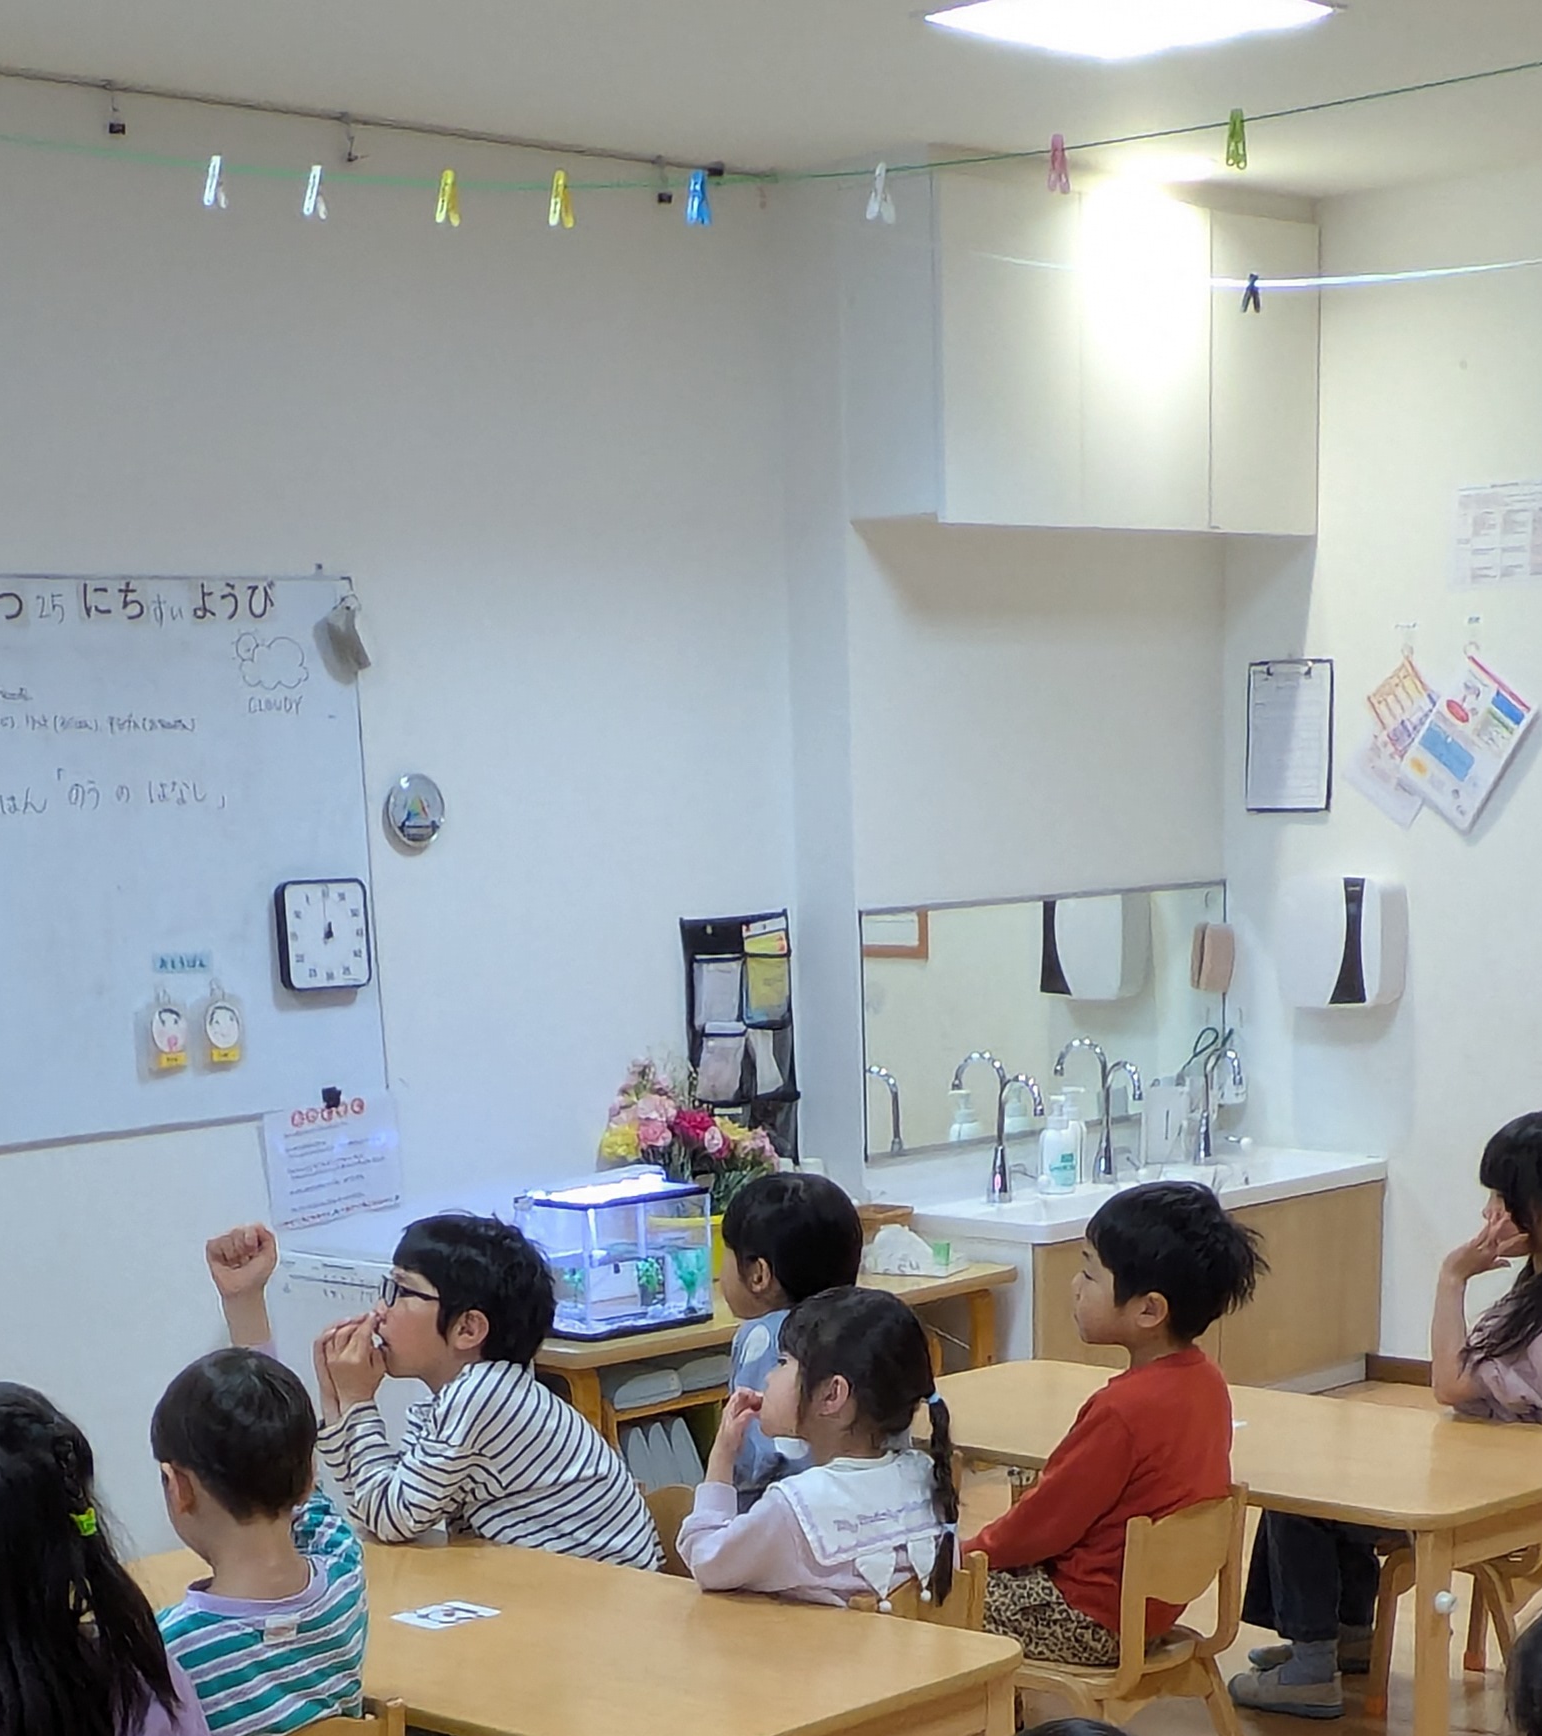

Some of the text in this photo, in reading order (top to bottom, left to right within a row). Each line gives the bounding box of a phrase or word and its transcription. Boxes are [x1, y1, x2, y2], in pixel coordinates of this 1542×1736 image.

[36, 593, 66, 626] 25
[82, 581, 145, 621] にち
[193, 580, 275, 621] ようび
[247, 695, 303, 716] CLOUDY
